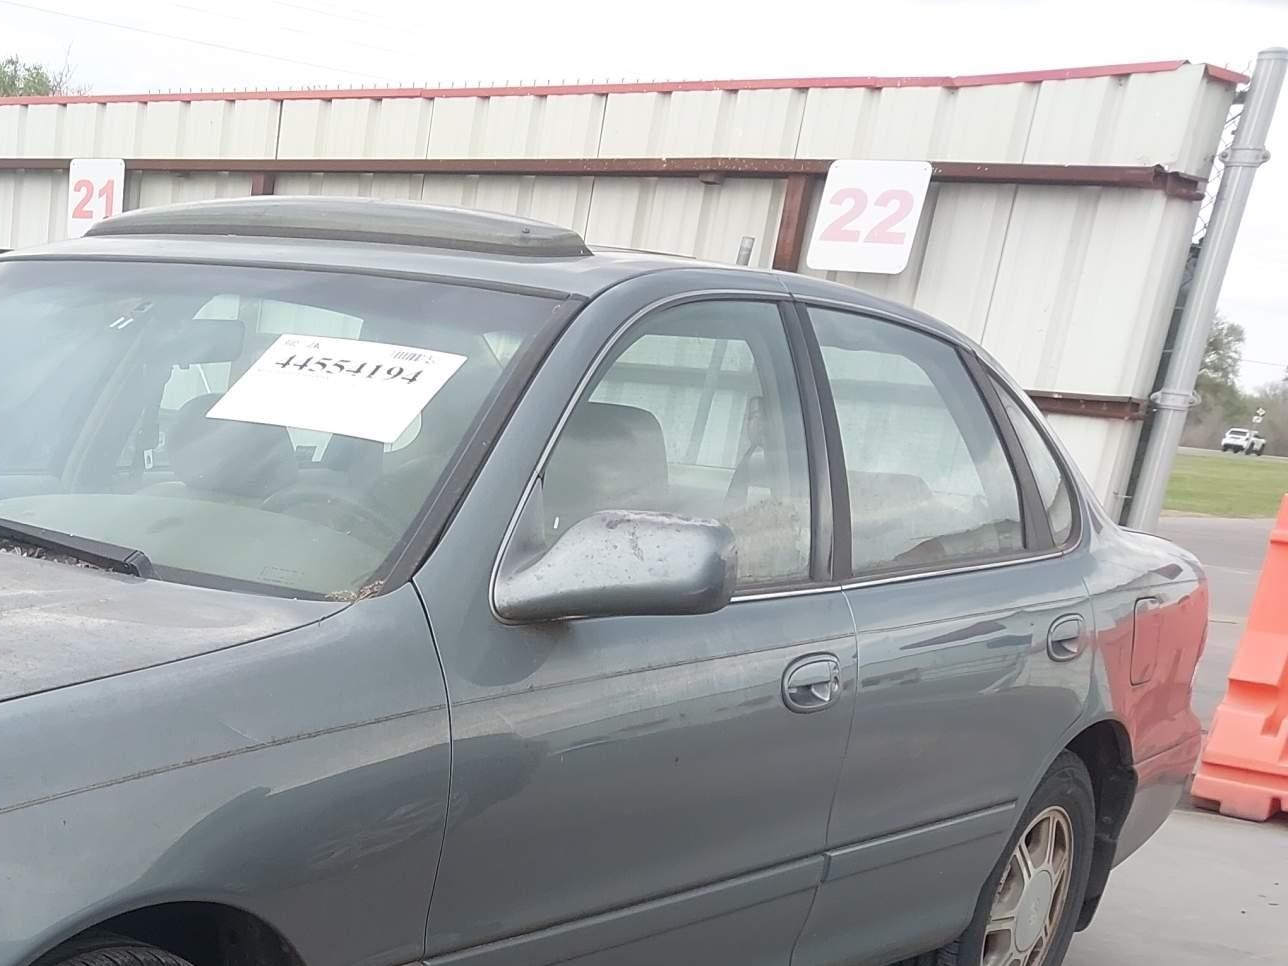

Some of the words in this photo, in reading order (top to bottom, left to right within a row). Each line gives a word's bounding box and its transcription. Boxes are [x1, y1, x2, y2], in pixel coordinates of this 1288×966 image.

[72, 179, 114, 219] 21
[818, 187, 914, 245] 22
[275, 354, 423, 384] 44554194
